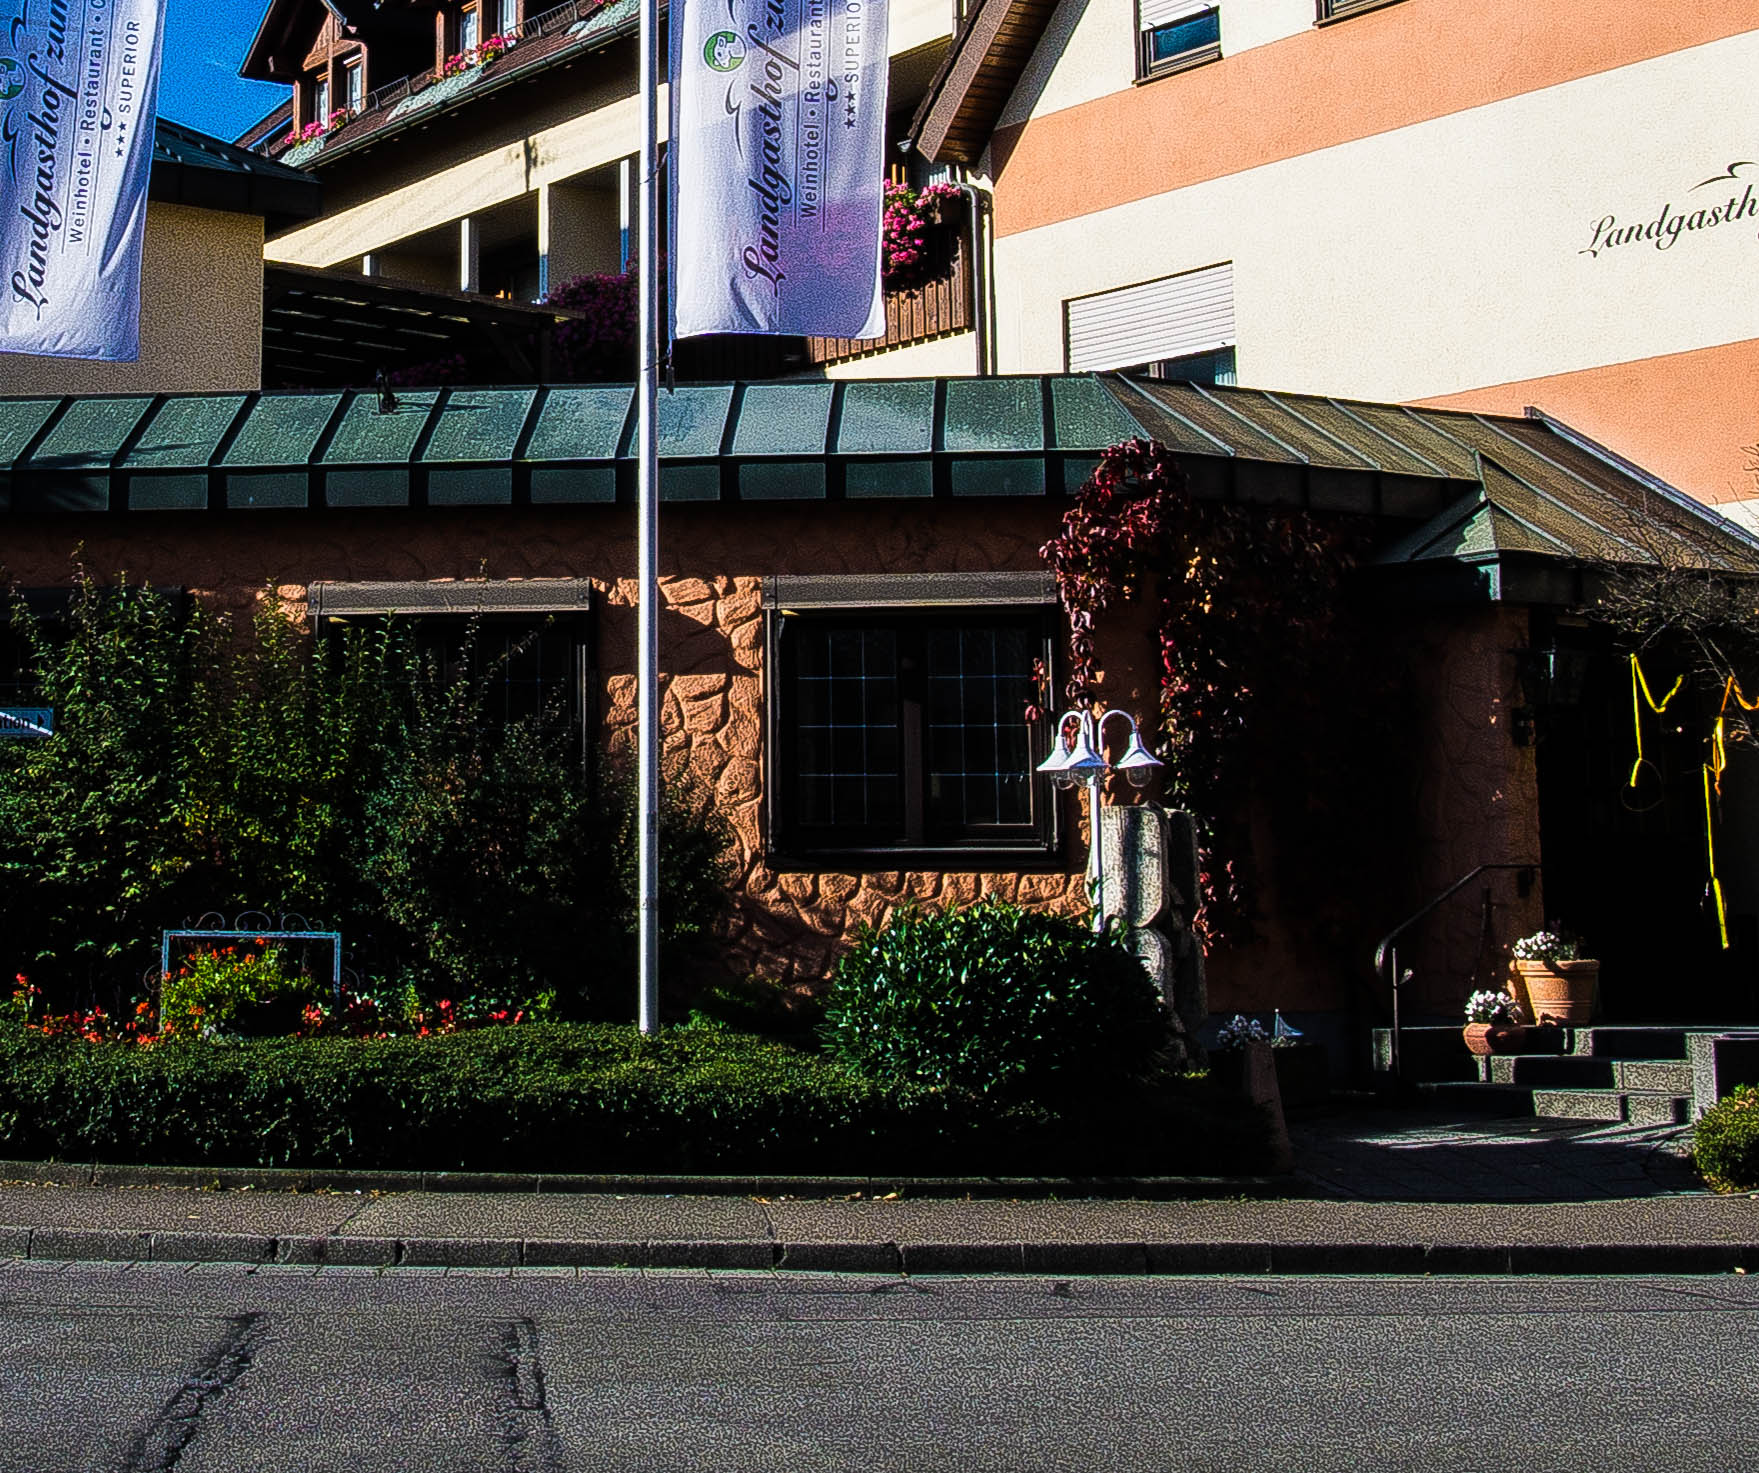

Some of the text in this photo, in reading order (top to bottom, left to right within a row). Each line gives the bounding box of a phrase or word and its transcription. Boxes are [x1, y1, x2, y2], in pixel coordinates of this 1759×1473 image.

[69, 151, 92, 243] Weinhotel
[81, 28, 104, 131] Restaurant
[119, 20, 141, 113] SUPERIOR
[743, 23, 838, 298] Landgasthof
[800, 123, 820, 219] Weinhotel
[11, 52, 112, 321] Landgasthof
